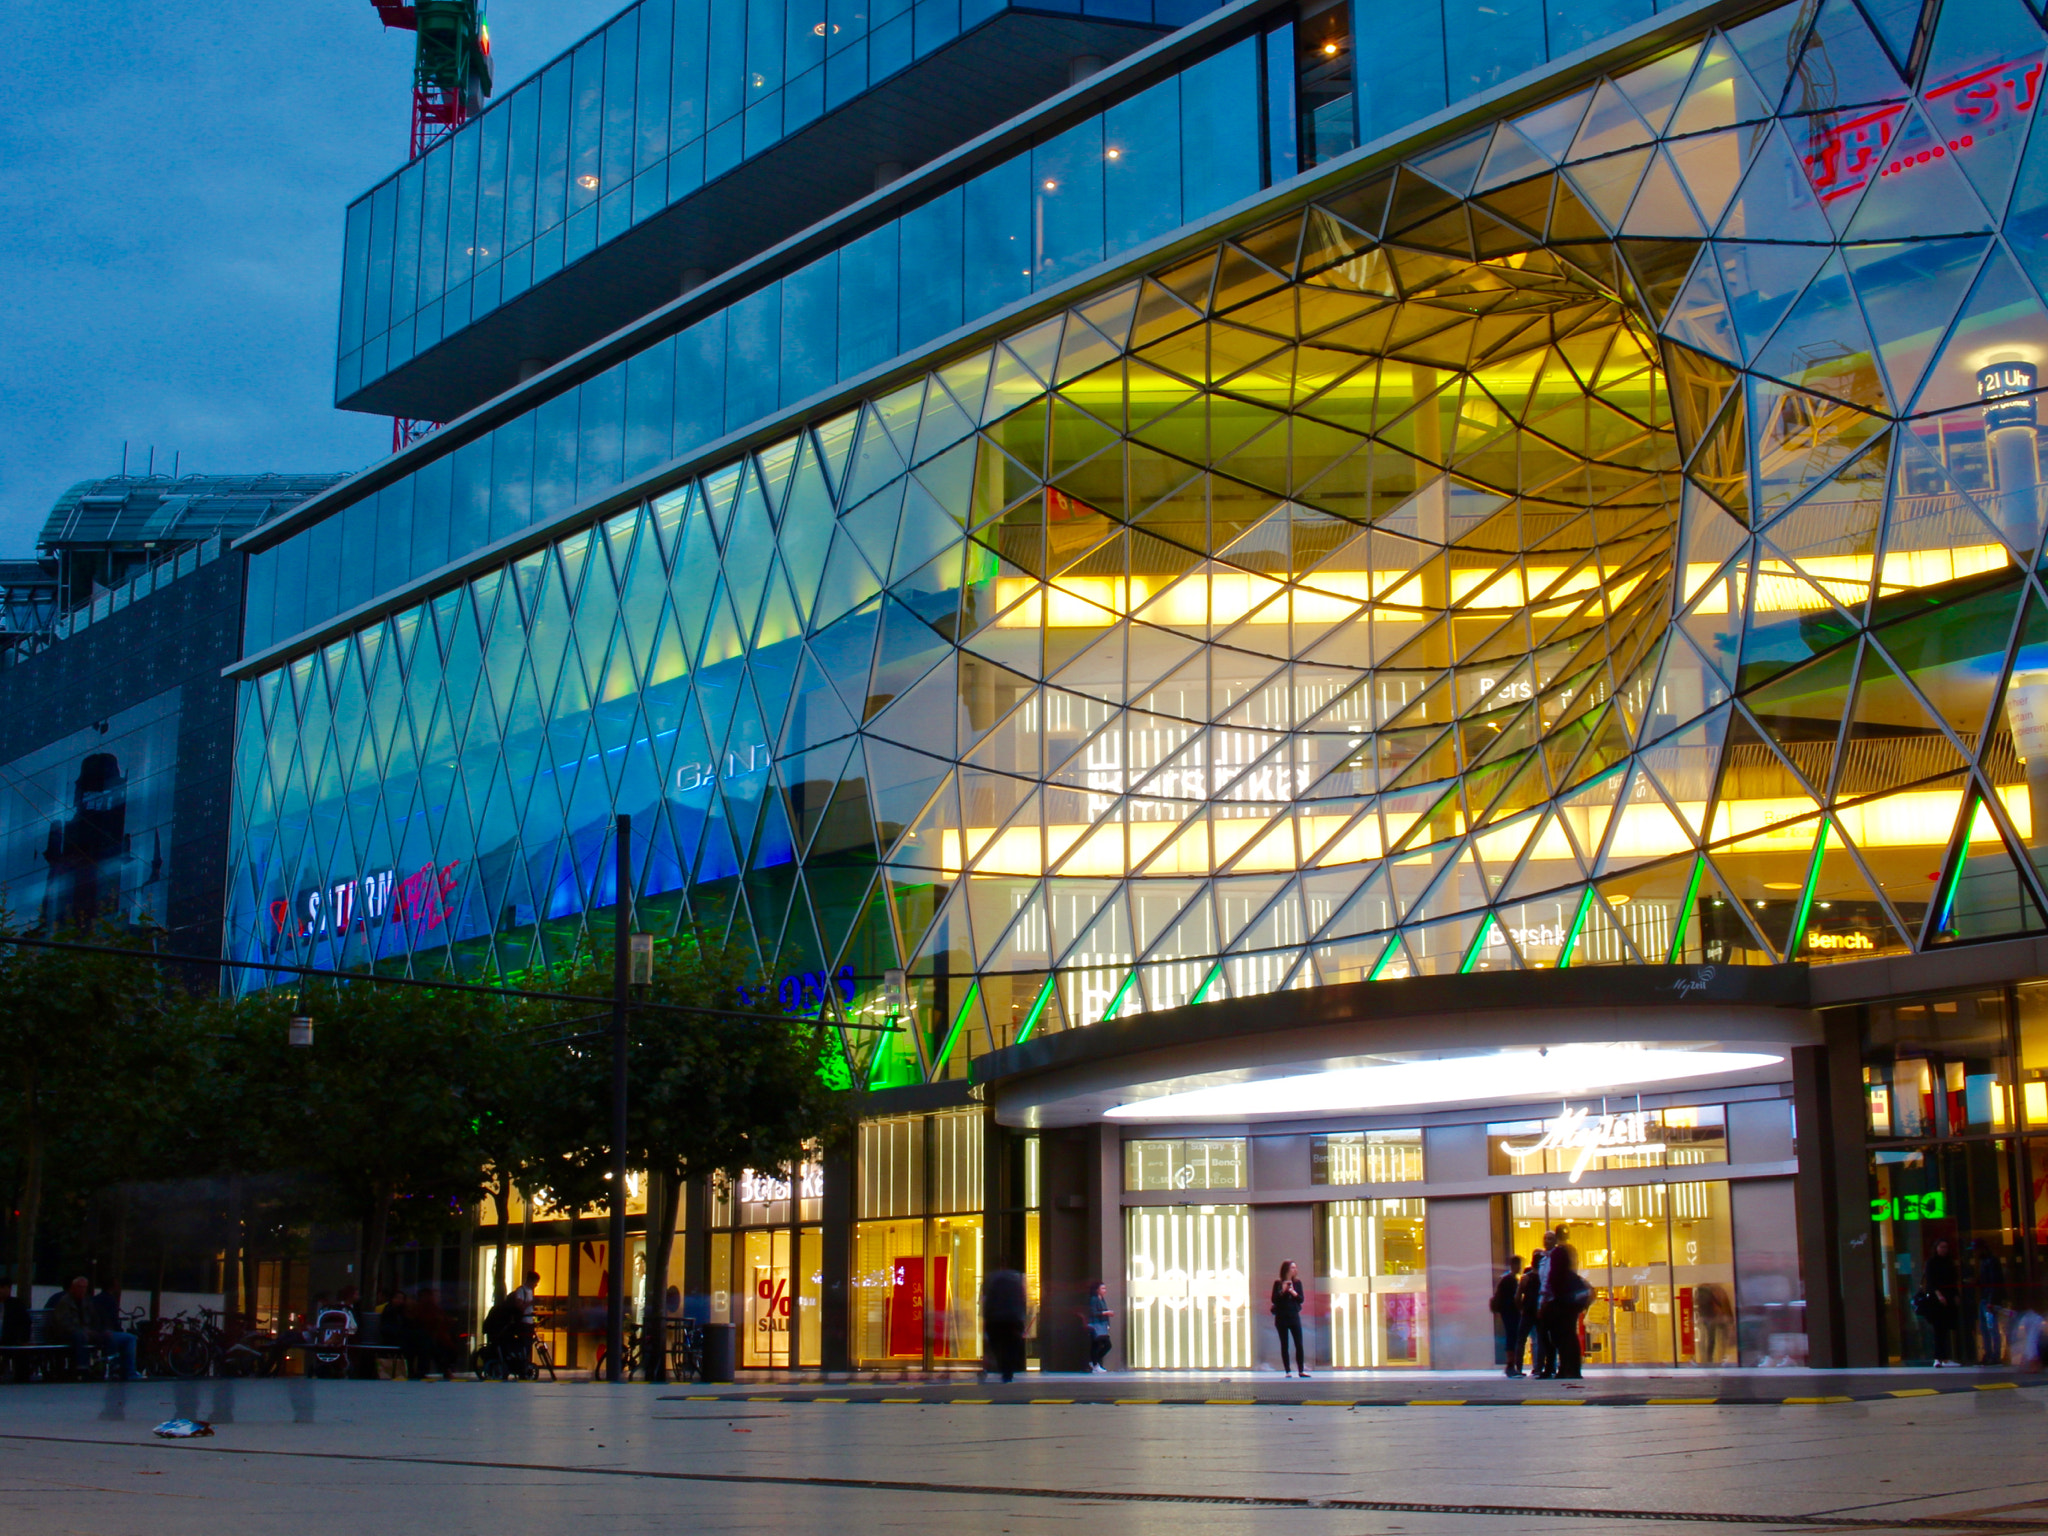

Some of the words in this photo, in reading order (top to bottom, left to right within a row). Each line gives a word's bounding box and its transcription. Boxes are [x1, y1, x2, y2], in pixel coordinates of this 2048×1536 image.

[1984, 371, 2001, 392] 21
[2004, 369, 2031, 387] Uhr
[1808, 930, 1875, 949] Bench.
[1500, 1106, 1648, 1184] MyZeil
